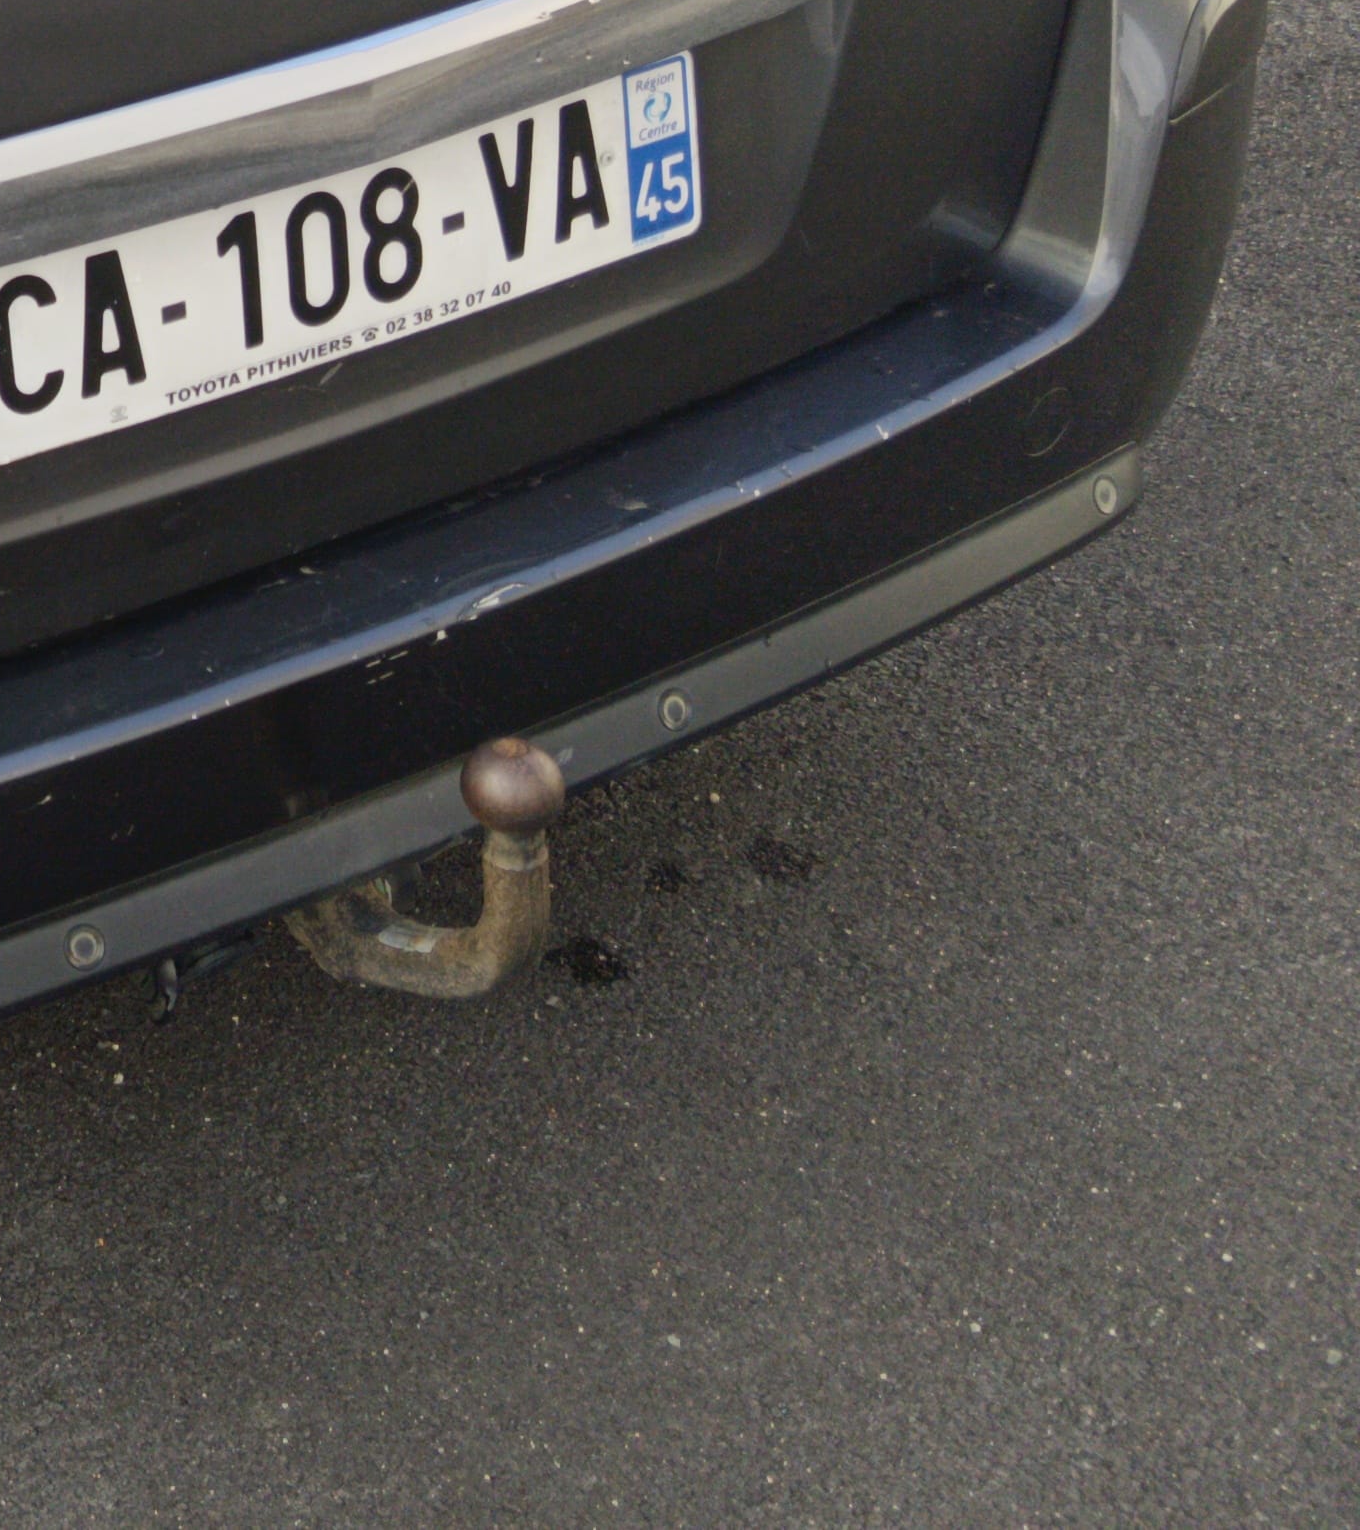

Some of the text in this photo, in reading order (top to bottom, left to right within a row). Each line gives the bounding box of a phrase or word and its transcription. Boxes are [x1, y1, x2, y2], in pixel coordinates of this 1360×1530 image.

[635, 72, 675, 93] Région
[638, 120, 678, 141] Centre
[635, 151, 689, 222] 45
[165, 280, 512, 406] TOYOTA PITHIVIERS 02 38 32 07 40
